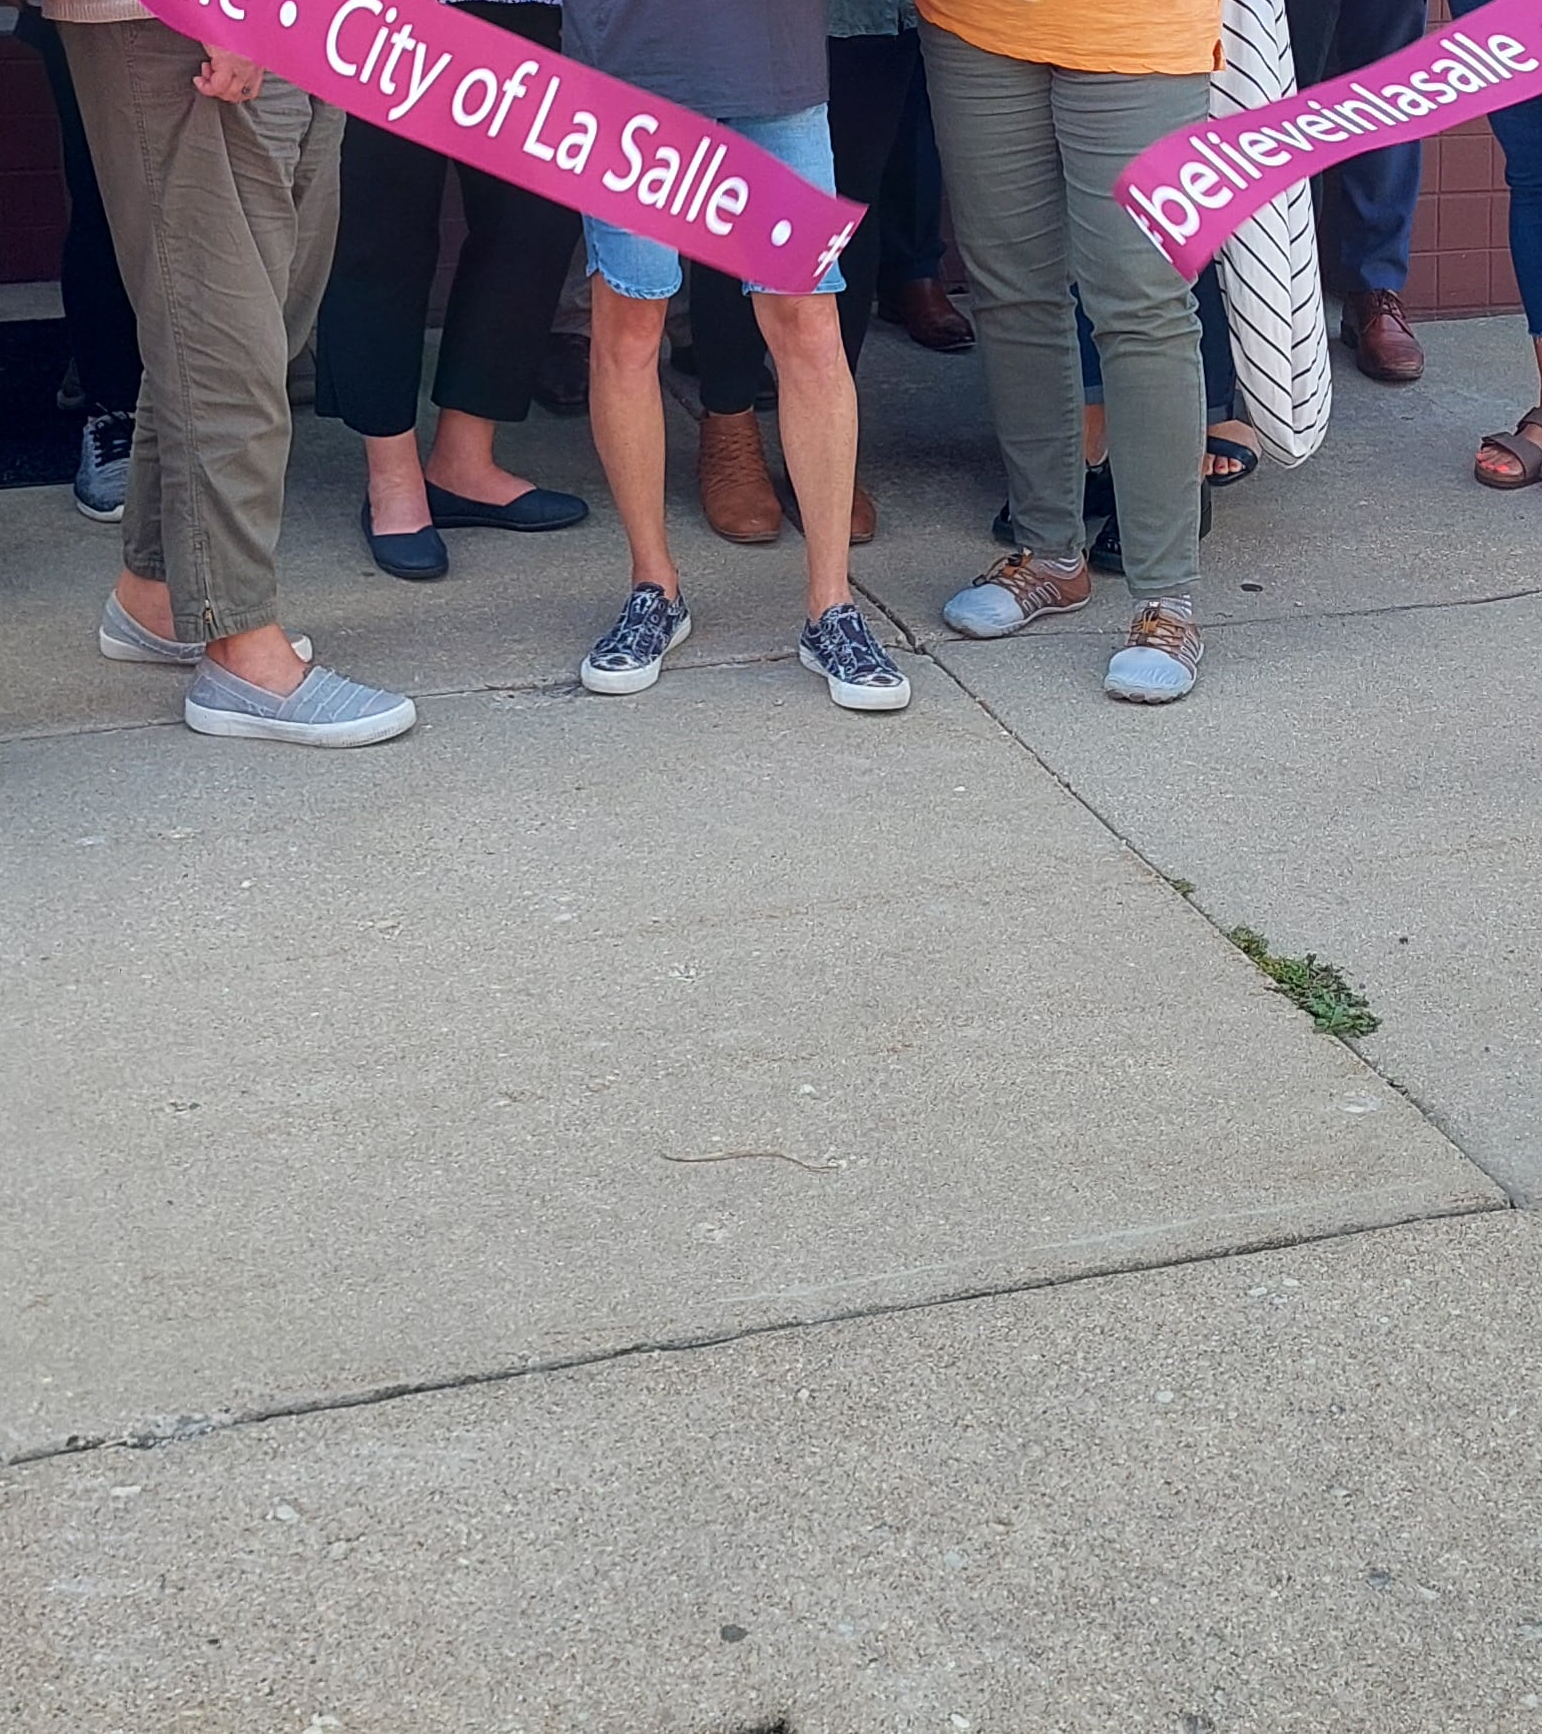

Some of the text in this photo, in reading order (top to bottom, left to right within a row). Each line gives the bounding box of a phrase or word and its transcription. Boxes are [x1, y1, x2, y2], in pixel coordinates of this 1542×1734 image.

[453, 61, 540, 137] of
[523, 77, 598, 174] La
[602, 115, 749, 236] Salle
